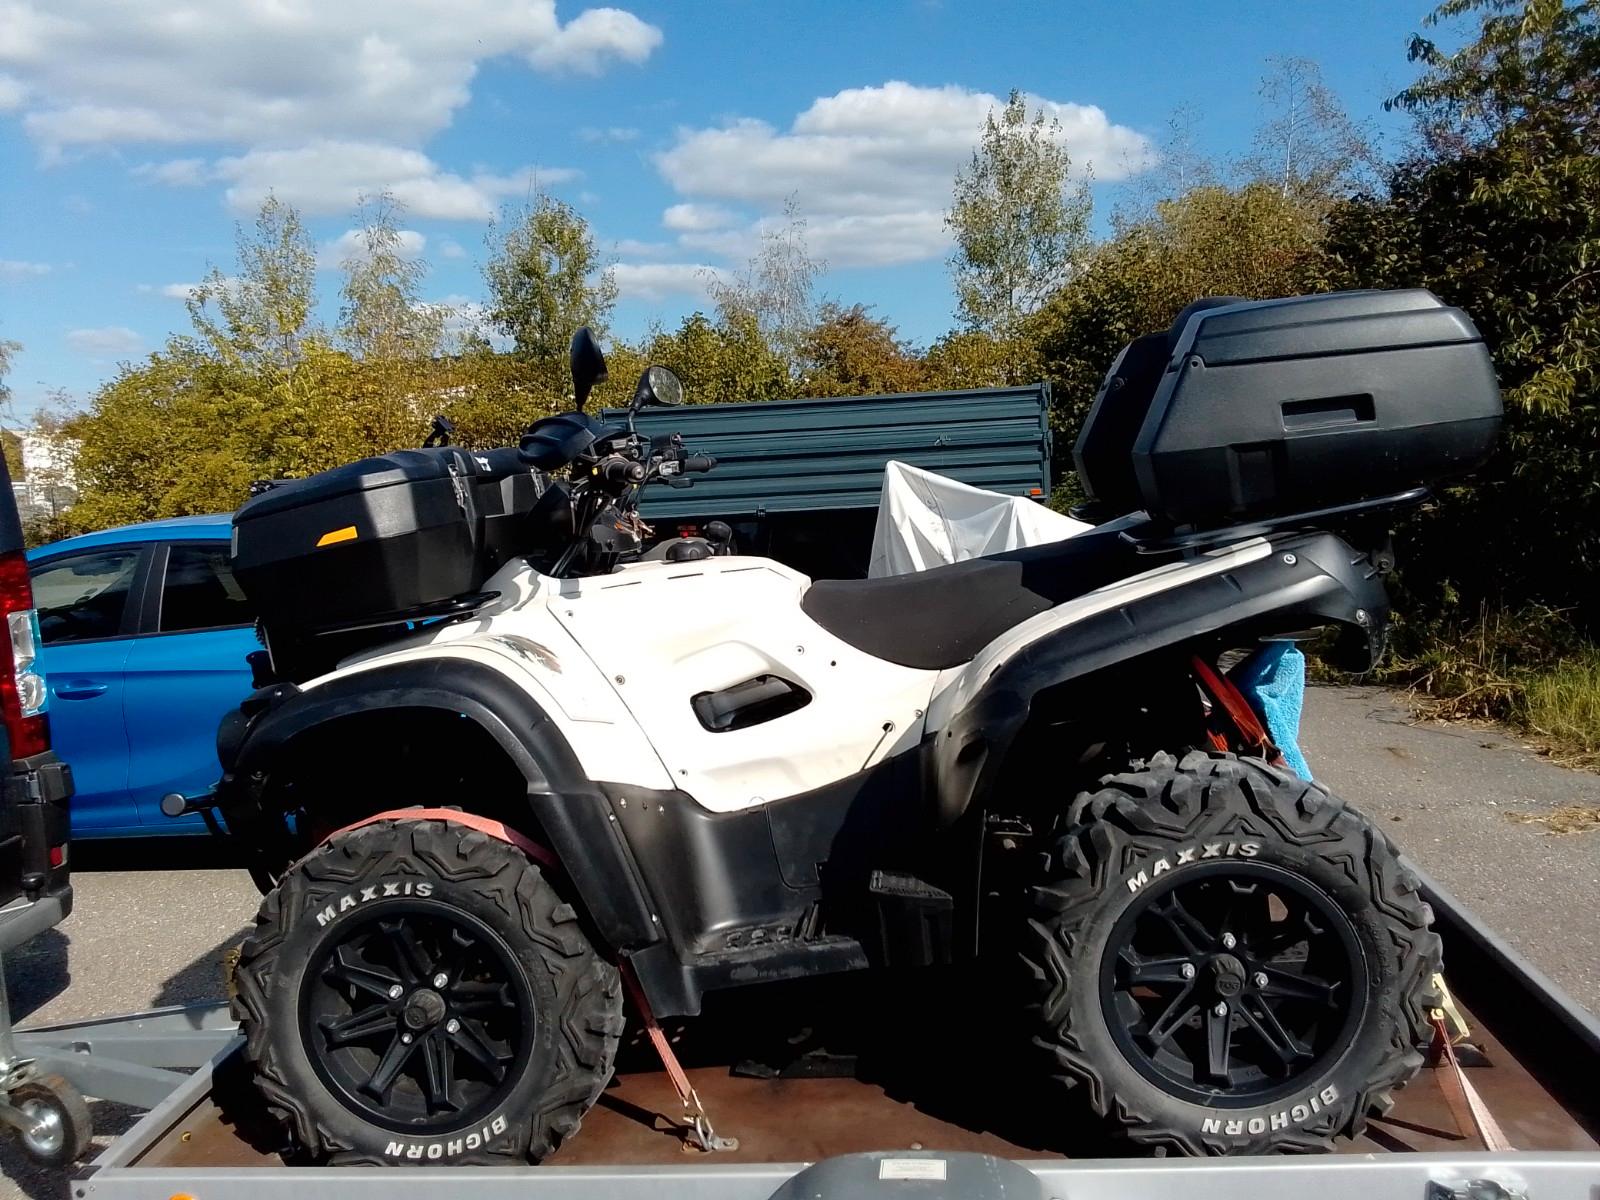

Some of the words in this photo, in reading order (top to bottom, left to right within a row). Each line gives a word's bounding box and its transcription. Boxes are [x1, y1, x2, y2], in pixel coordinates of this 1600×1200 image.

[1127, 842, 1259, 893] MAXXIS
[316, 882, 434, 926] MAXXIS
[1202, 1084, 1339, 1135] BIGHORN
[385, 1114, 507, 1158] BIGHORN
